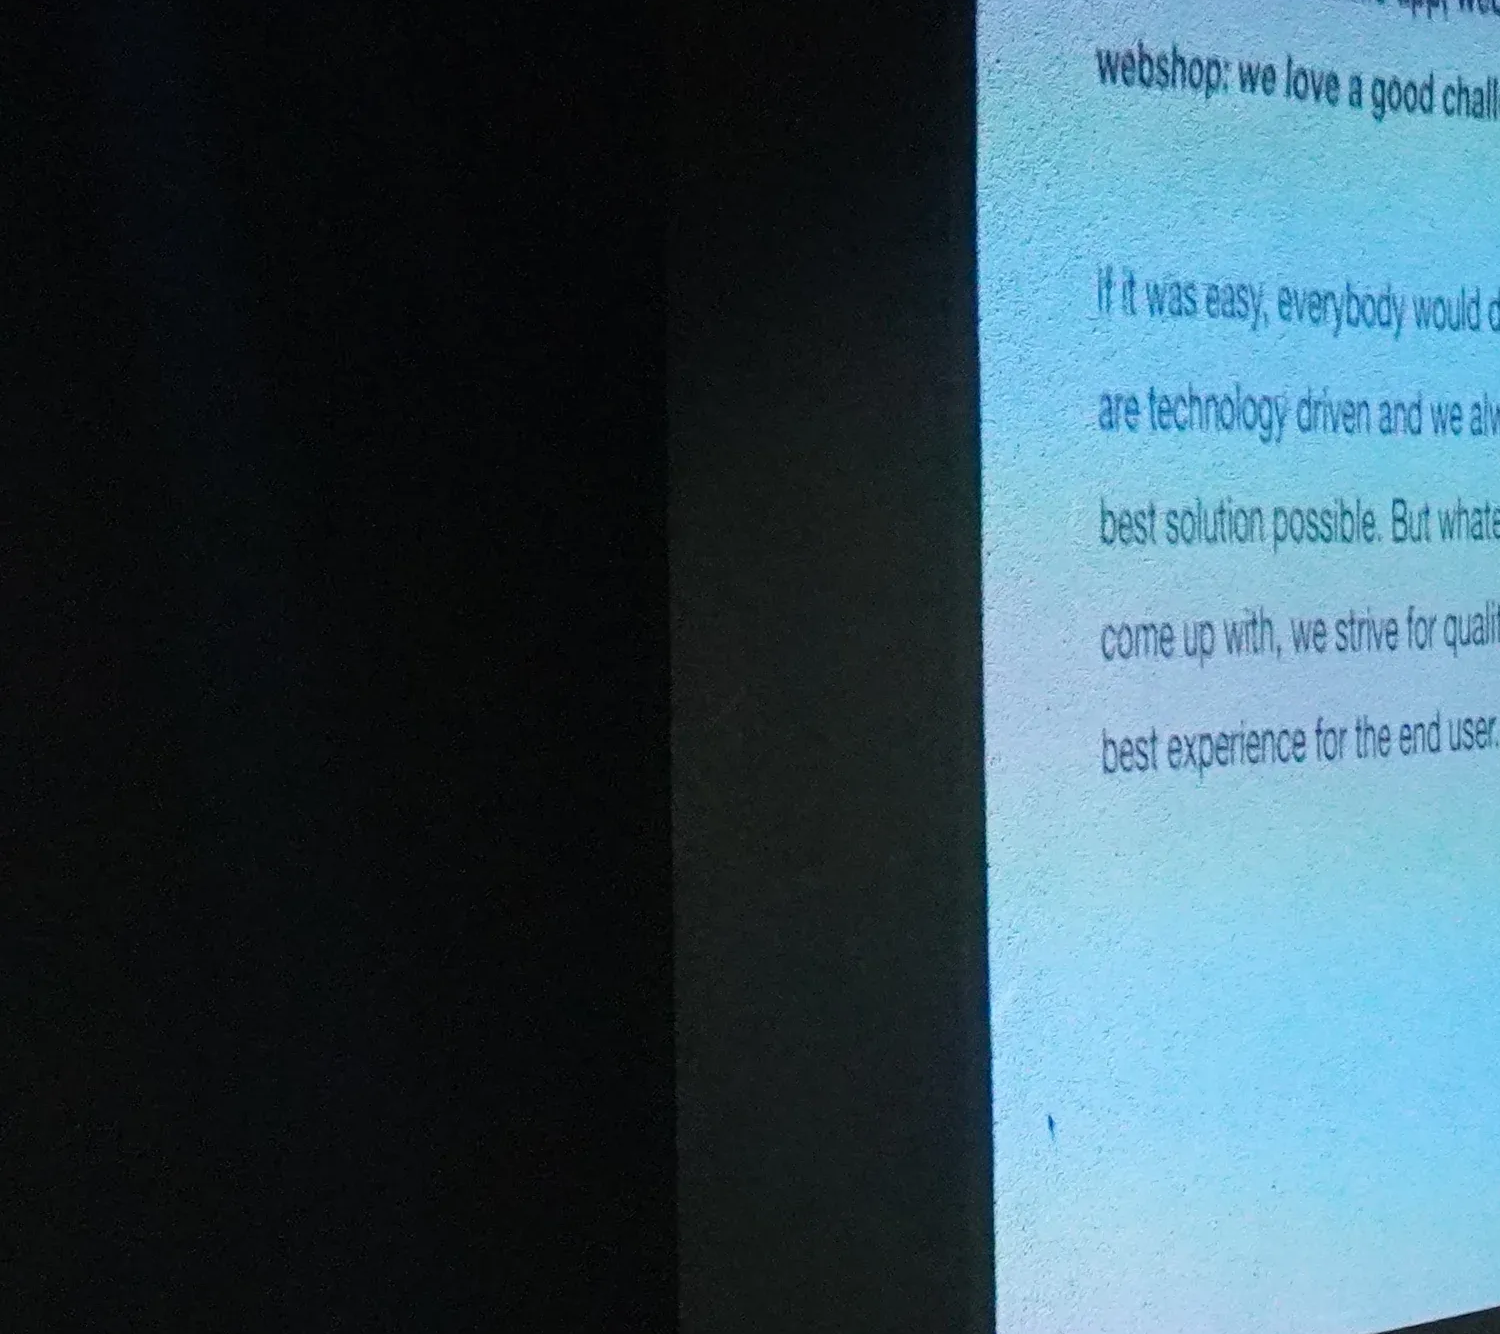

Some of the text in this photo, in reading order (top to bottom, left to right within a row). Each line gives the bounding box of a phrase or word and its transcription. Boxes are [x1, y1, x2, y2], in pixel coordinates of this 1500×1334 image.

[1096, 43, 1228, 99] webshop:
[1238, 61, 1275, 97] we
[1285, 54, 1338, 106] love
[1349, 75, 1362, 109] a
[1371, 72, 1434, 123] good
[1097, 267, 1116, 318] If
[1122, 266, 1137, 316] it
[1146, 279, 1196, 317] was
[1204, 282, 1267, 331] easy,
[1277, 282, 1406, 341] everybody
[1412, 287, 1480, 334] would
[1098, 391, 1140, 432] are
[1147, 383, 1288, 444] technology
[1296, 388, 1370, 435] driven
[1378, 394, 1421, 436] and
[1430, 403, 1463, 436] we
[1099, 497, 1157, 546] best
[1165, 499, 1266, 546] solution
[1272, 501, 1382, 553] possible.
[1392, 498, 1430, 543] But
[1100, 619, 1176, 661] come
[1184, 619, 1213, 669] up
[1223, 609, 1282, 661] with,
[1290, 615, 1326, 653] we
[1335, 608, 1398, 653] strive
[1406, 606, 1437, 651] for
[1101, 712, 1500, 779] best experience for the end user.
